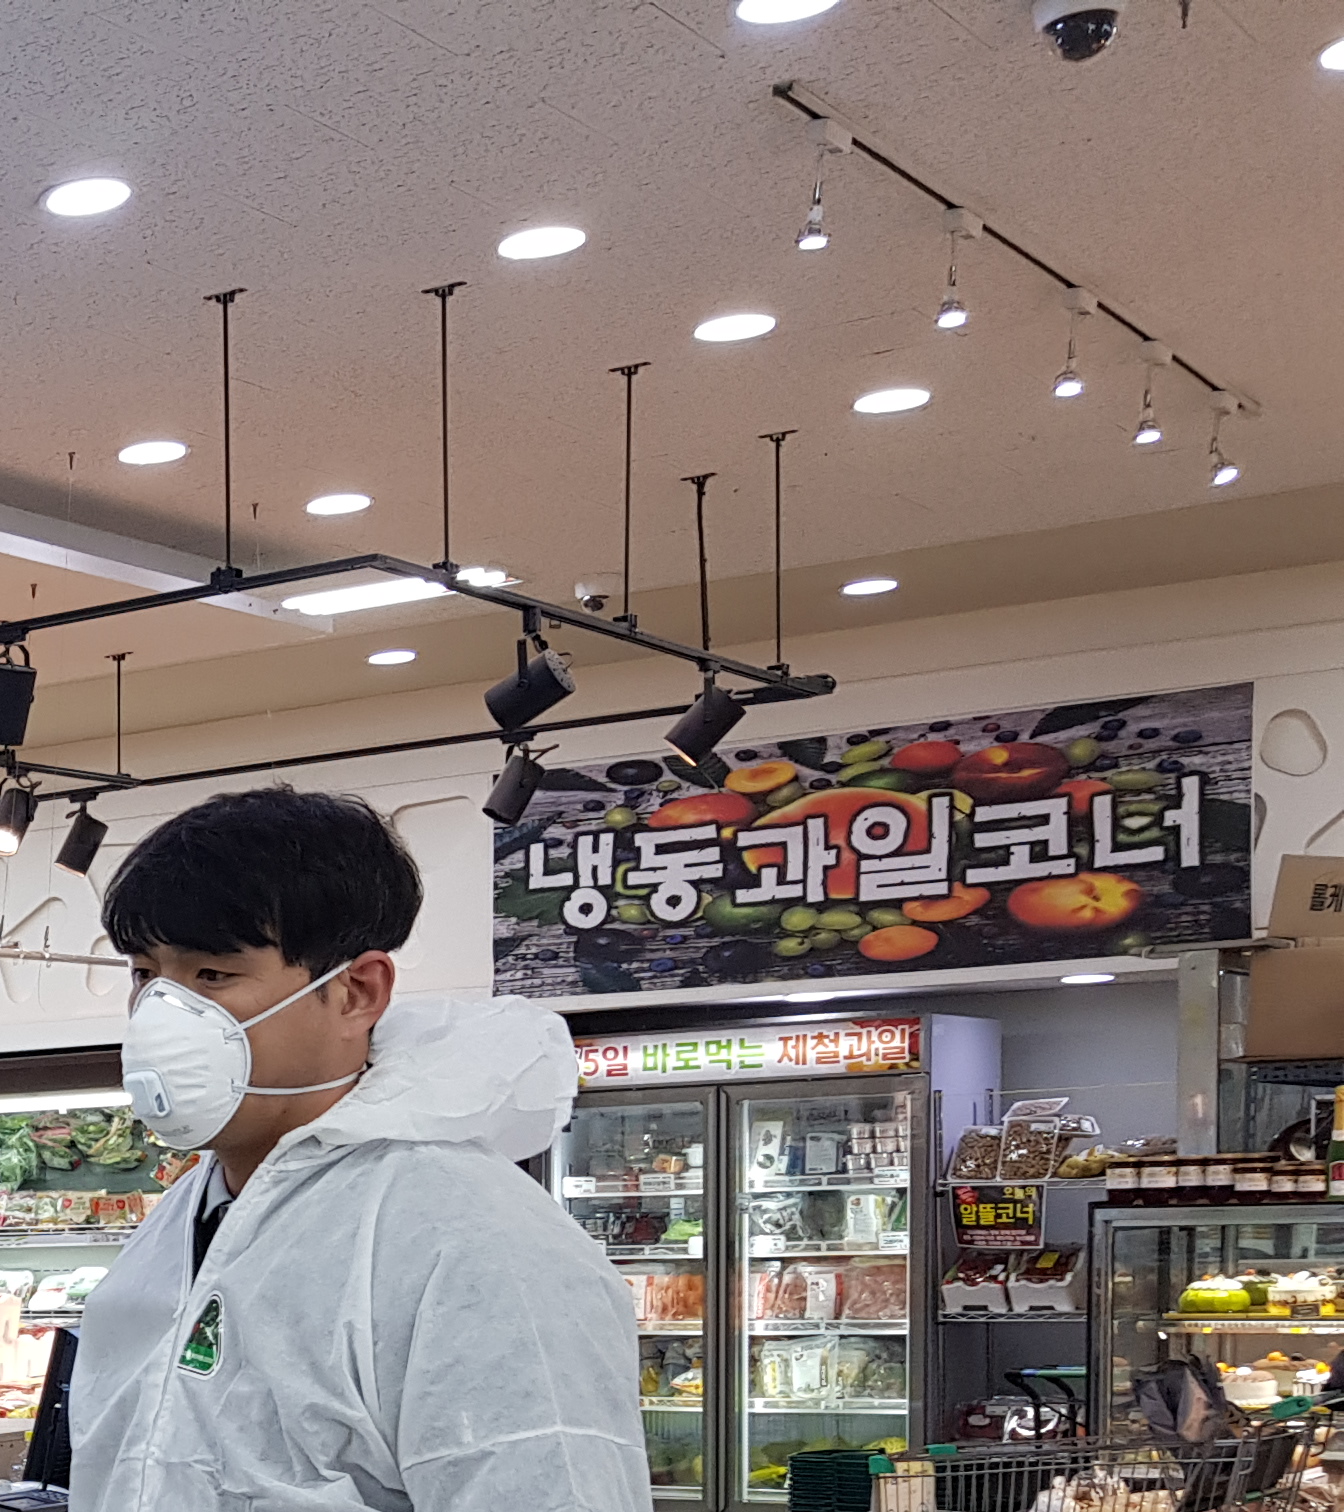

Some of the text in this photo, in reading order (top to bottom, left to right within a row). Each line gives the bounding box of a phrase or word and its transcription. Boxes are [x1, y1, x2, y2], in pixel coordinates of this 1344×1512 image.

[527, 775, 1205, 930] 냉동과일코너
[576, 1027, 907, 1077] 5일 바로먹는 제철과일
[1002, 1187, 1036, 1199] 오늘의
[960, 1204, 1034, 1225] 알뜰코너
